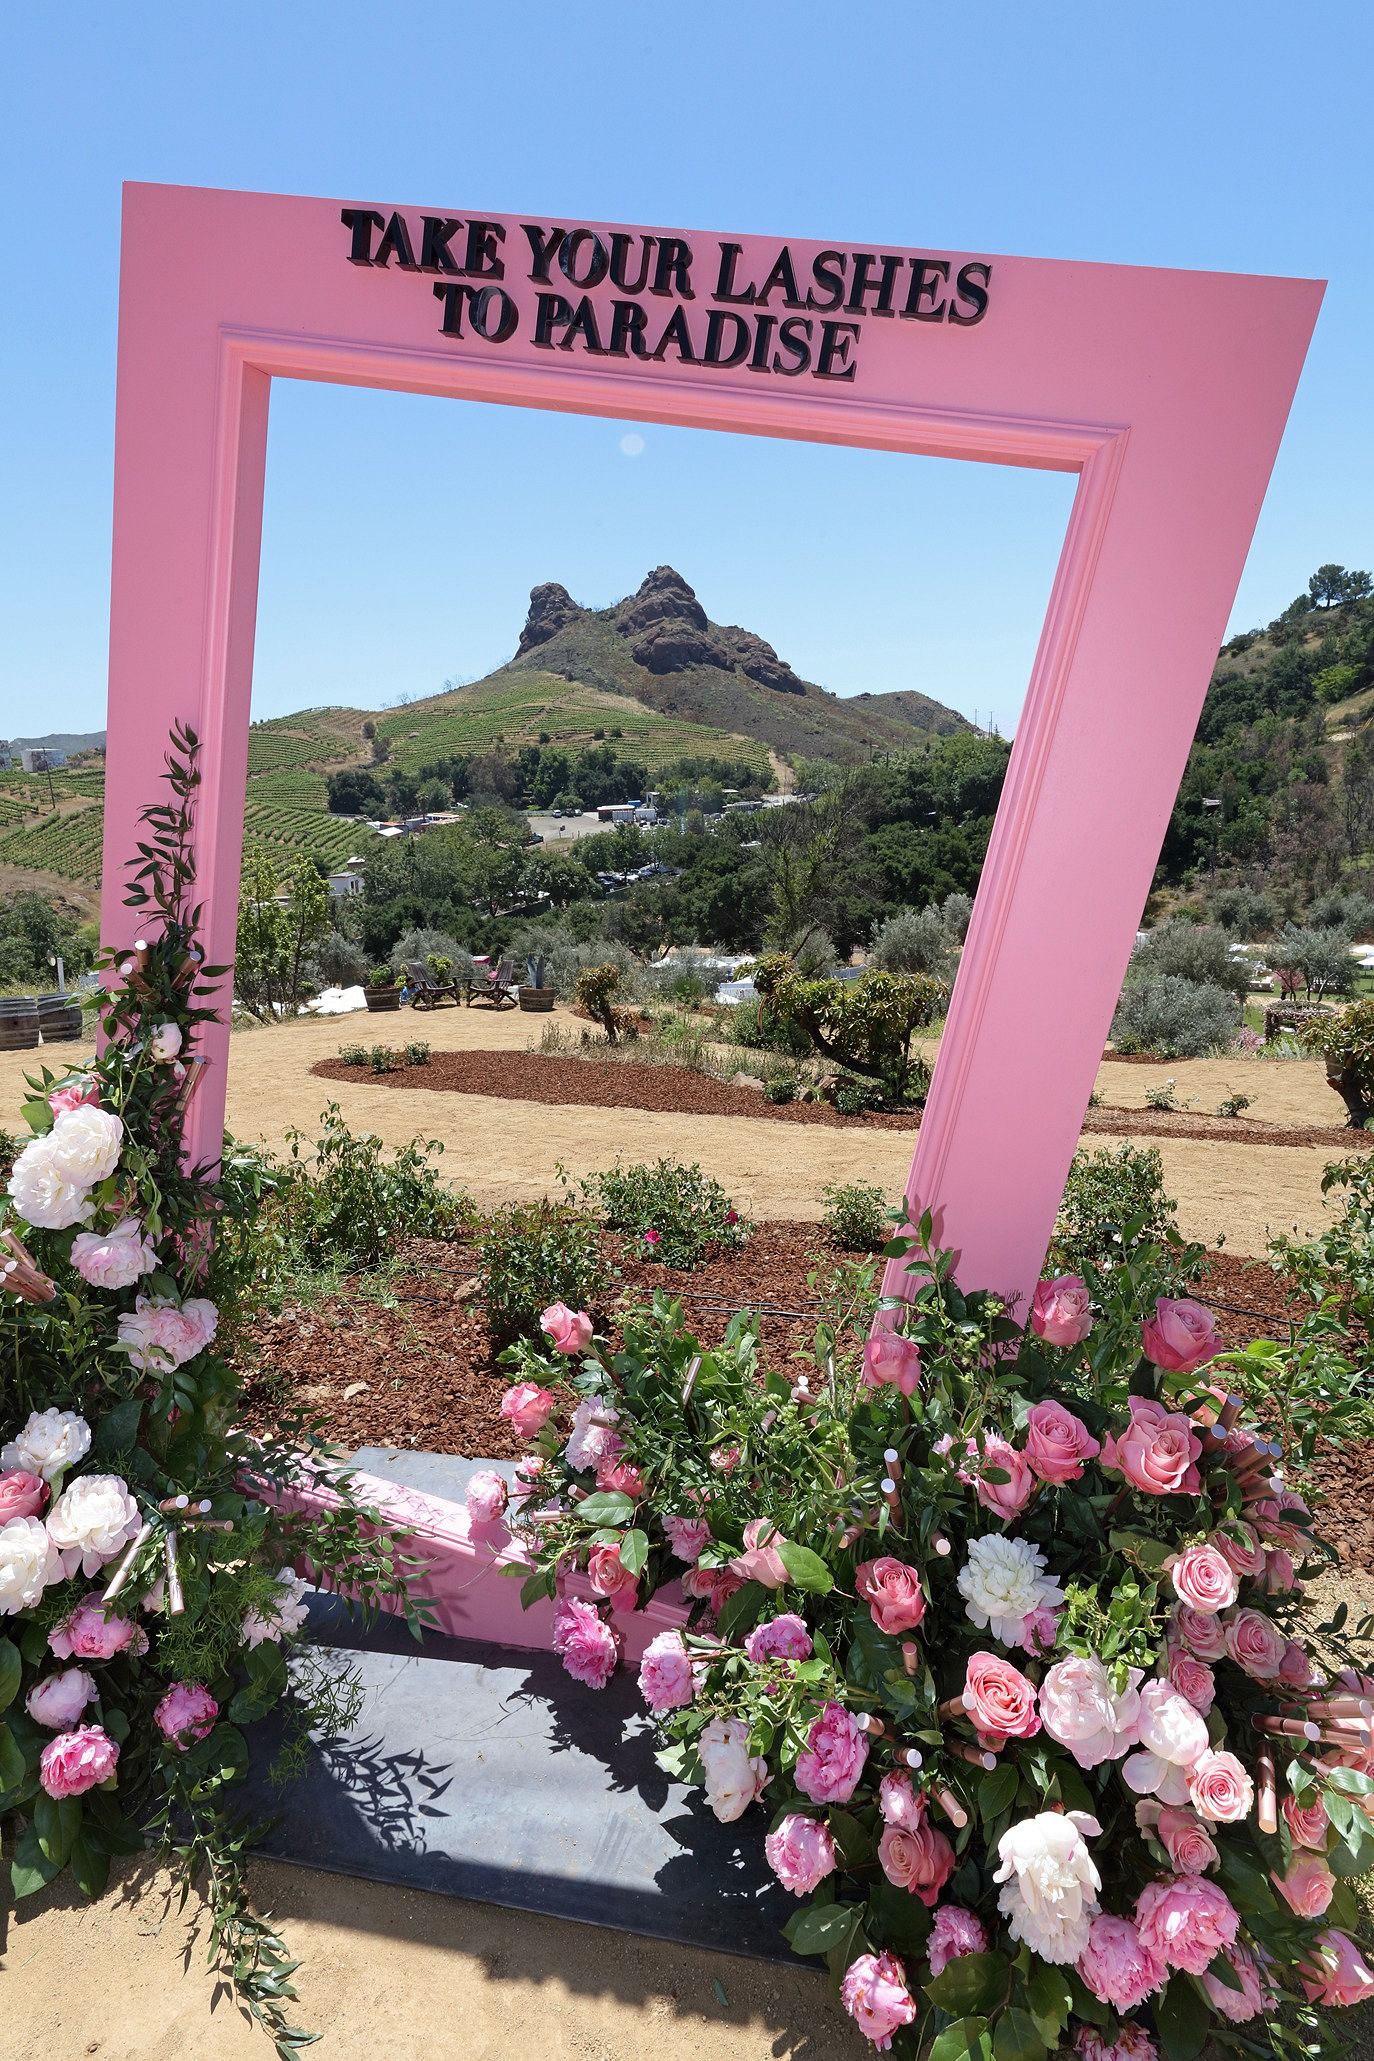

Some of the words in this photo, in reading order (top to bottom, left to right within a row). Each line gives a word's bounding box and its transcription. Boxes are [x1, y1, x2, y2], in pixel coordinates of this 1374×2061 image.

[341, 208, 506, 281] TAKE
[519, 223, 697, 300] YOUR
[711, 241, 993, 327] LASHES
[432, 281, 519, 344] TO
[530, 291, 861, 383] PARADISE
